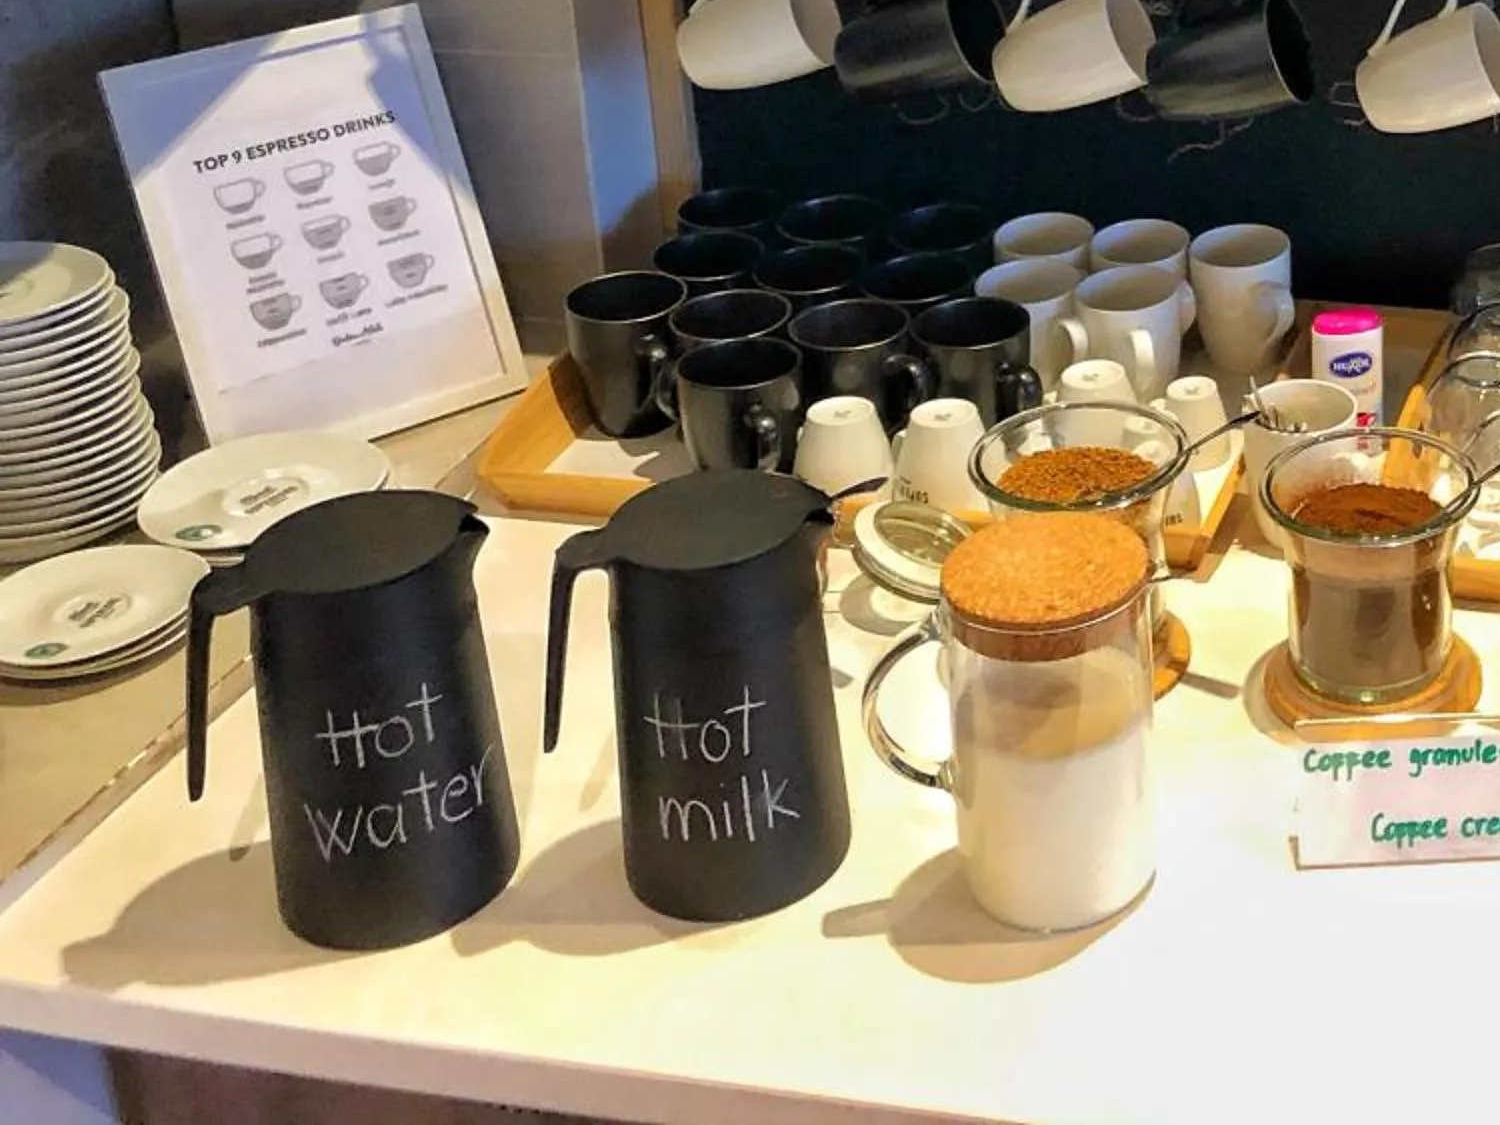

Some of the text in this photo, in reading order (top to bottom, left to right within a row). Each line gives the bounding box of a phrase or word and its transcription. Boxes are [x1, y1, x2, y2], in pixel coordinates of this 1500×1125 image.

[193, 110, 396, 174] TOP 9 ESPRESSO DRINKS
[314, 682, 444, 768] Hot
[643, 685, 767, 763] Hot
[659, 768, 800, 842] milk
